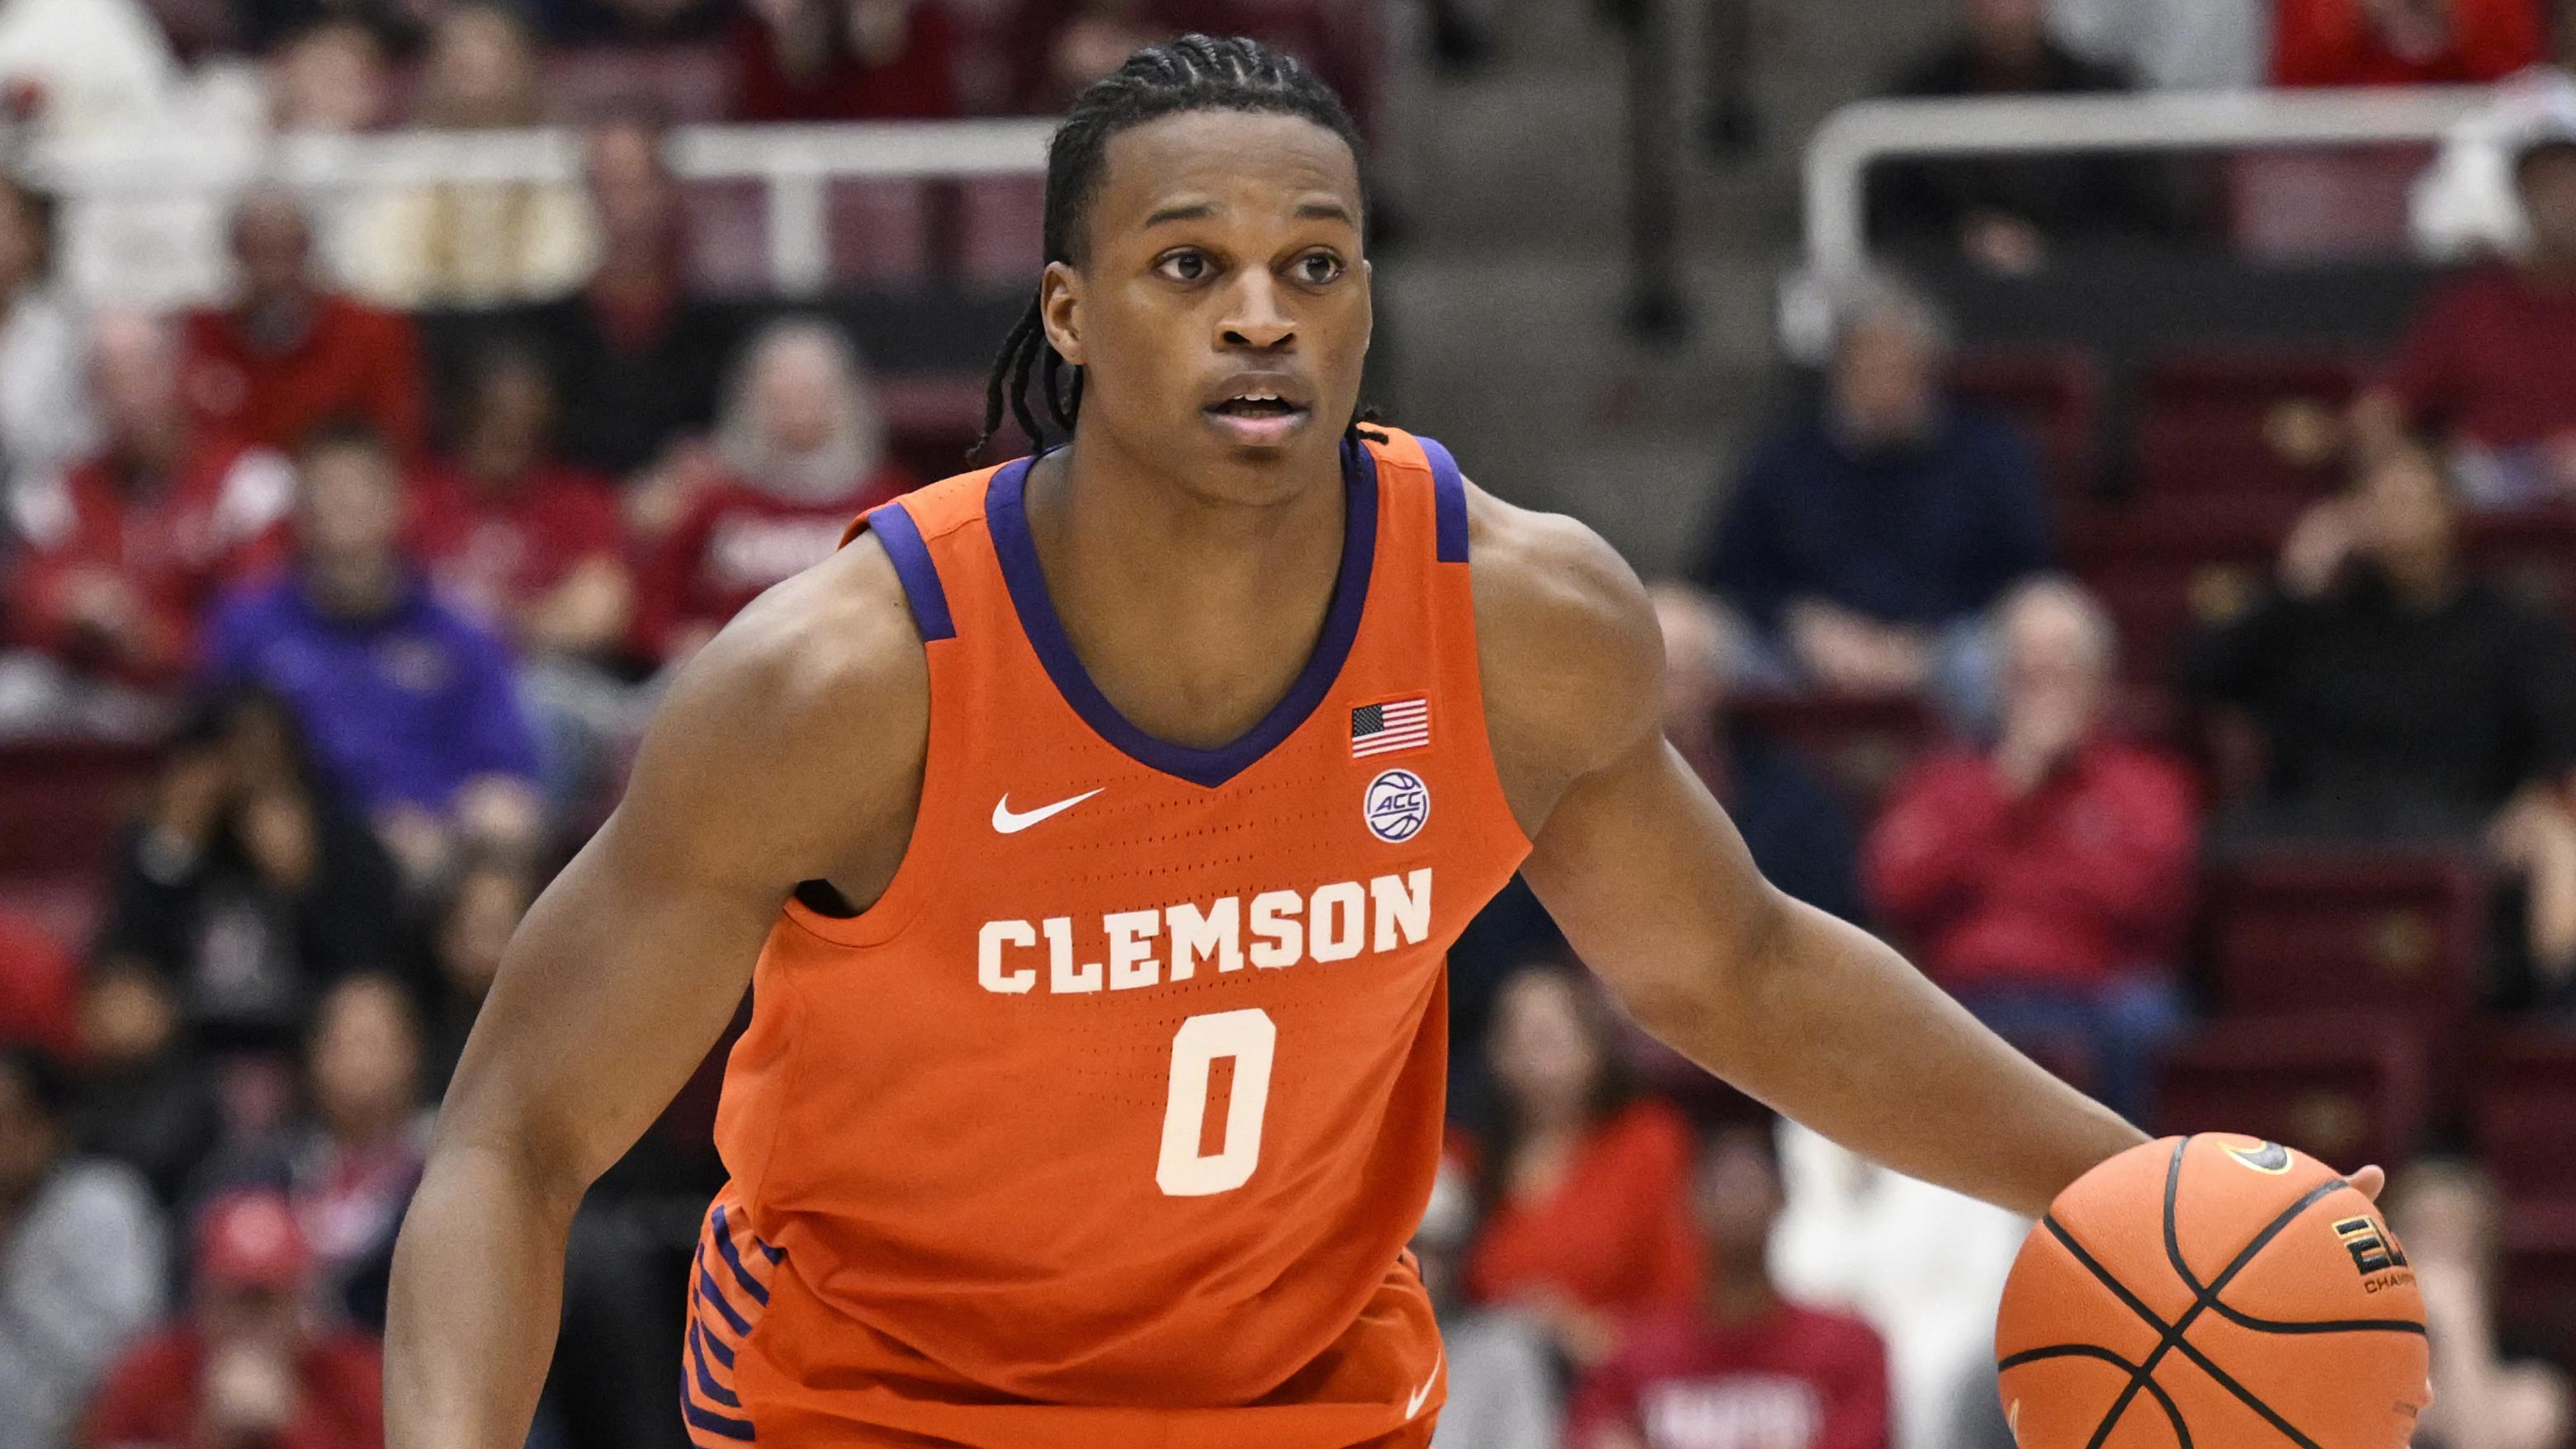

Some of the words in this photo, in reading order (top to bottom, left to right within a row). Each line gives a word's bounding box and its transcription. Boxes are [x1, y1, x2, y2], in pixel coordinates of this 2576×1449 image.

[1375, 791, 1423, 812] ACC
[978, 867, 1433, 994] CLEMSON
[1156, 1008, 1277, 1196] 0
